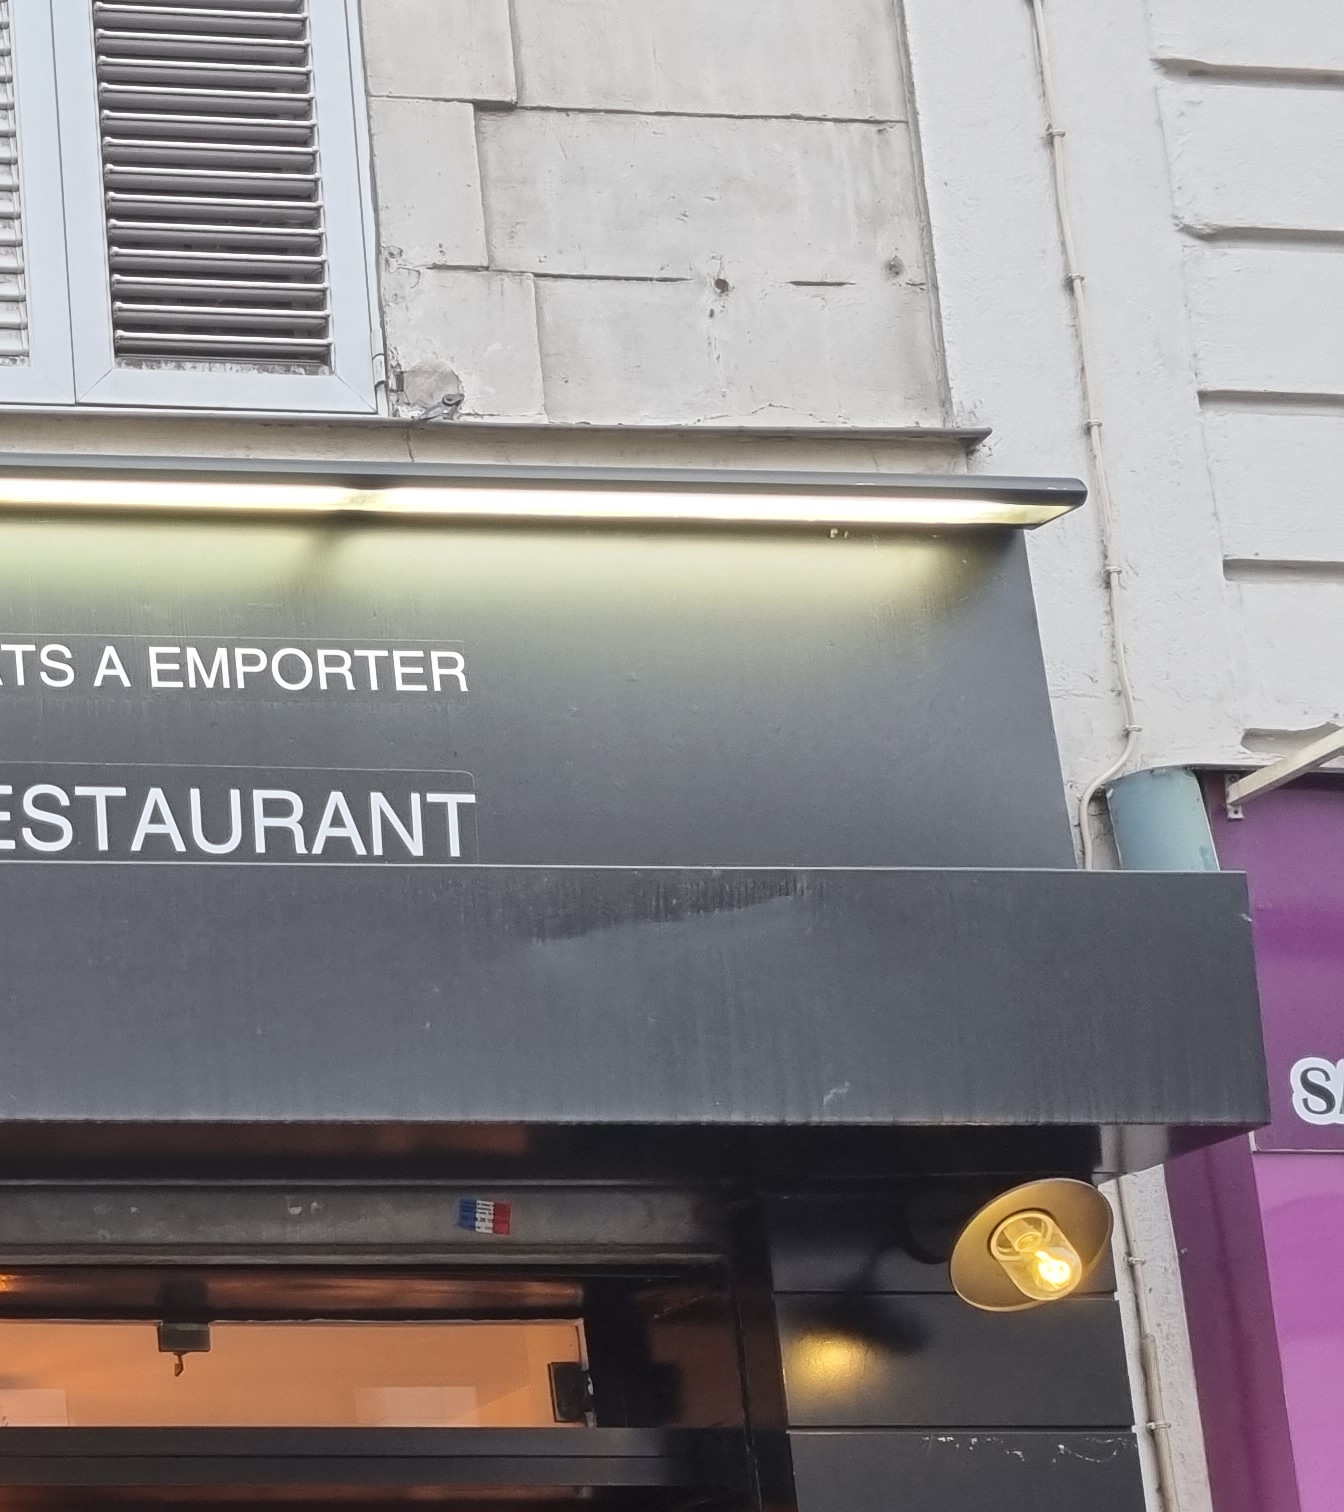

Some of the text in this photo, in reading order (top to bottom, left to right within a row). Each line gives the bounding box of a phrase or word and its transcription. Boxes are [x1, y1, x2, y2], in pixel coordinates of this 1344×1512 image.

[94, 646, 131, 687] A
[148, 647, 469, 692] EMPORTER
[1300, 1067, 1344, 1115] S
